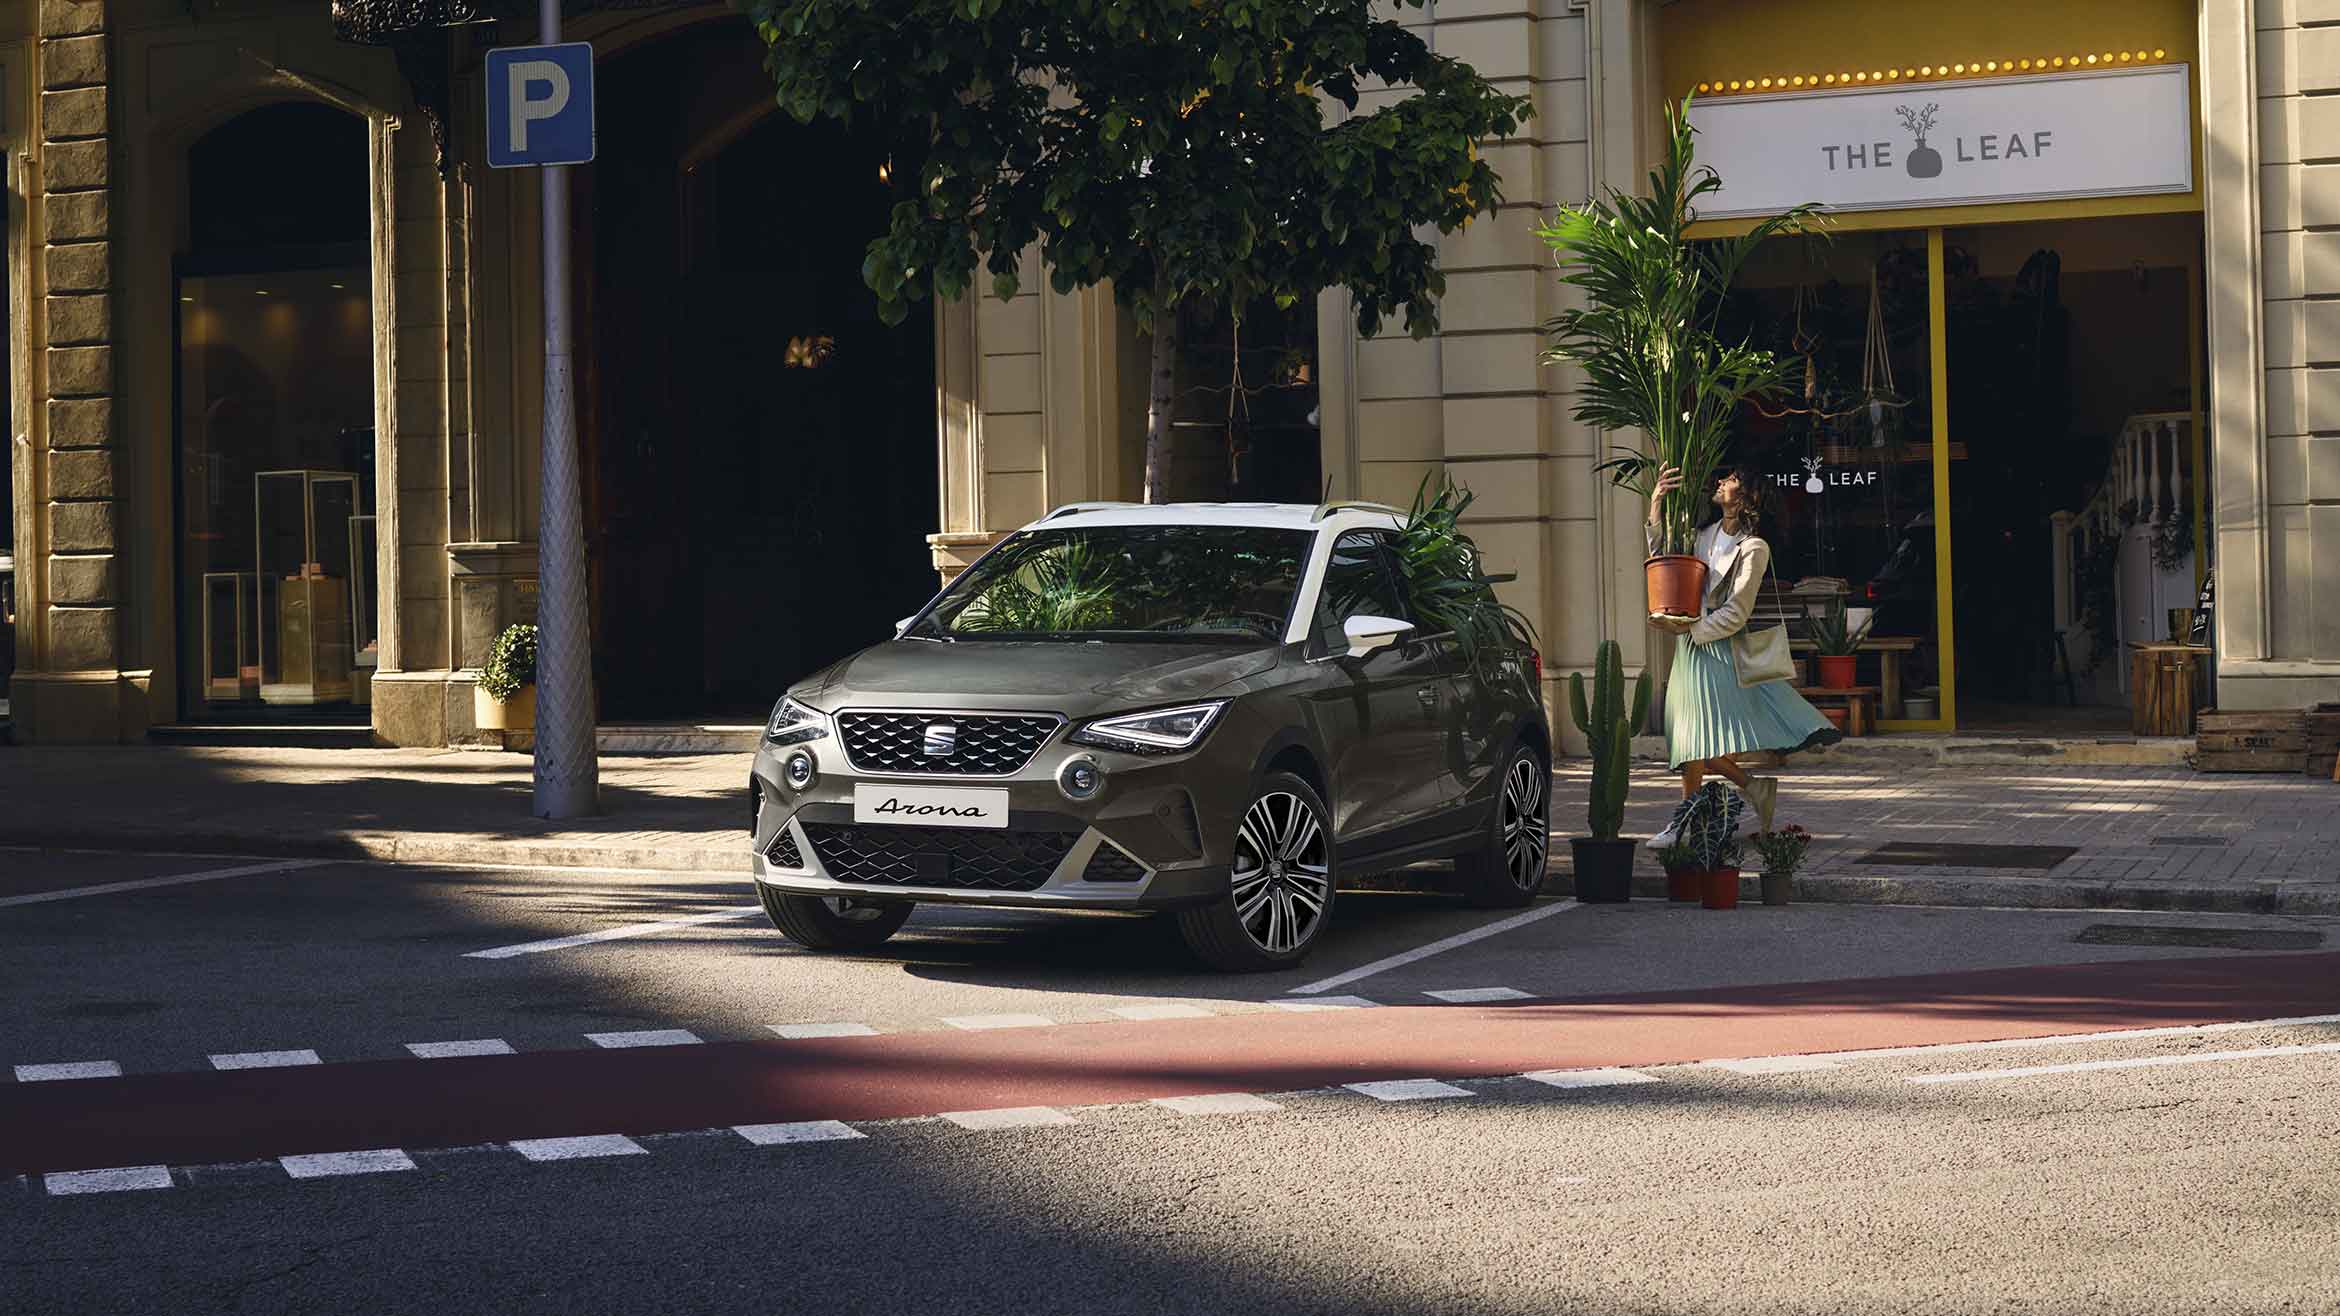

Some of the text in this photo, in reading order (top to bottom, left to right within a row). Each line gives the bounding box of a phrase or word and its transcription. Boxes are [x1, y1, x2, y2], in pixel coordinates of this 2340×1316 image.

[507, 60, 571, 152] P
[1821, 131, 2053, 171] THE LEAF
[1829, 471, 1877, 486] LEAF
[873, 797, 989, 819] Arona
